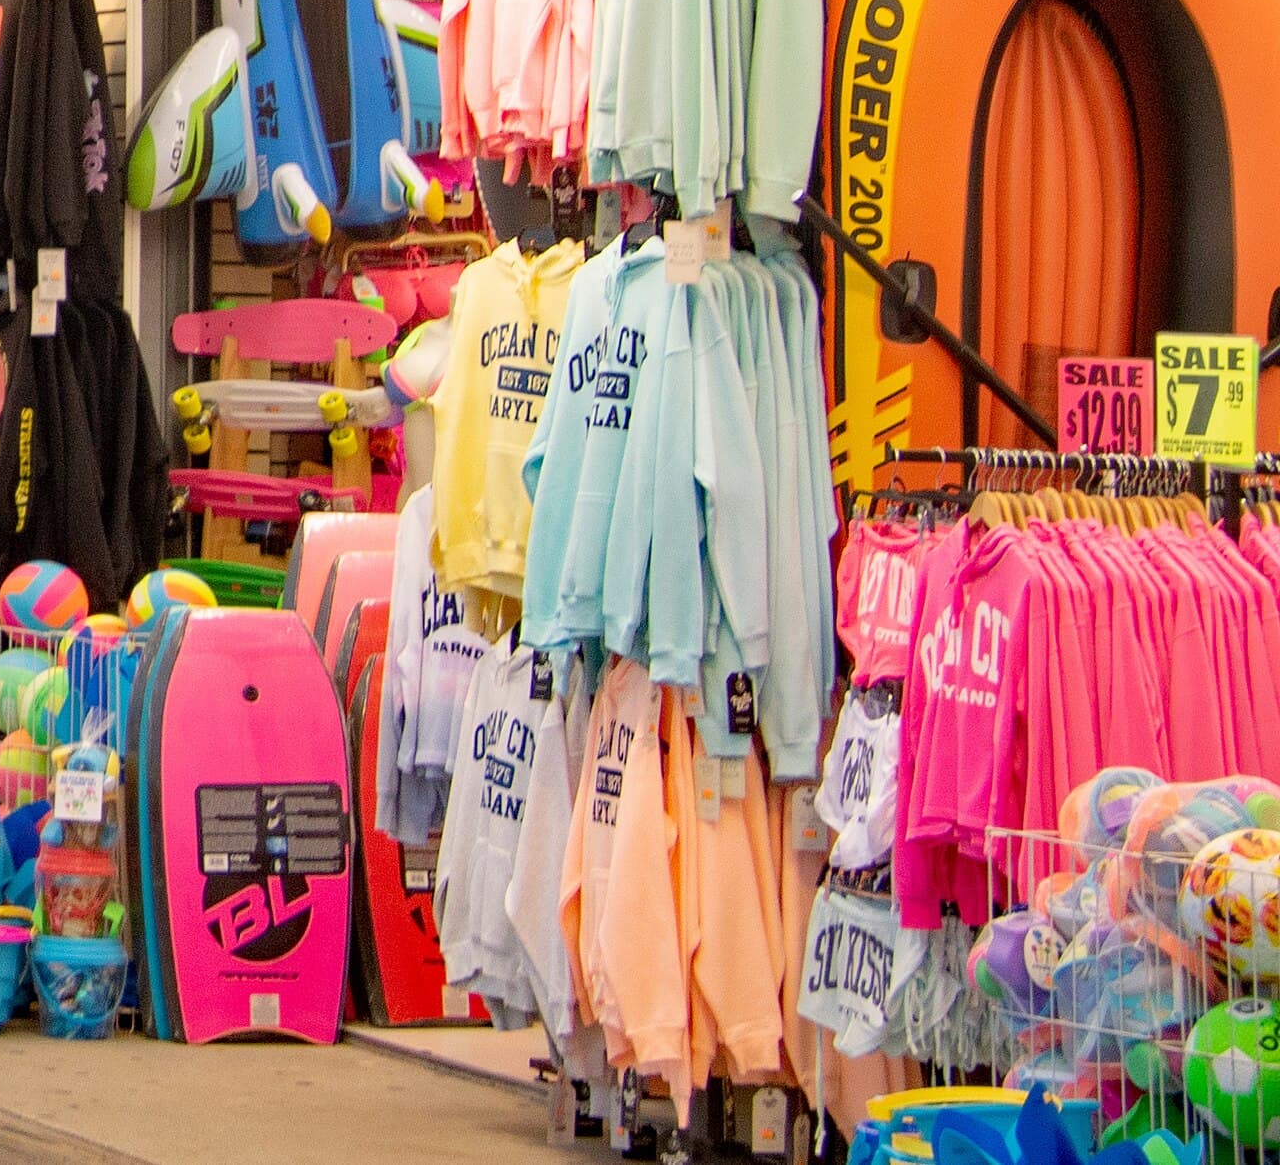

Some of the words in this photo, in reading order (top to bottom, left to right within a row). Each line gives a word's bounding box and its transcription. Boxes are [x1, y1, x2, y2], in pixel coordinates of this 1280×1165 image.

[168, 138, 184, 174] 107
[844, 177, 885, 253] 200
[480, 321, 538, 368] OCEAN
[1160, 346, 1245, 372] SALE
[1064, 362, 1143, 388] SALE
